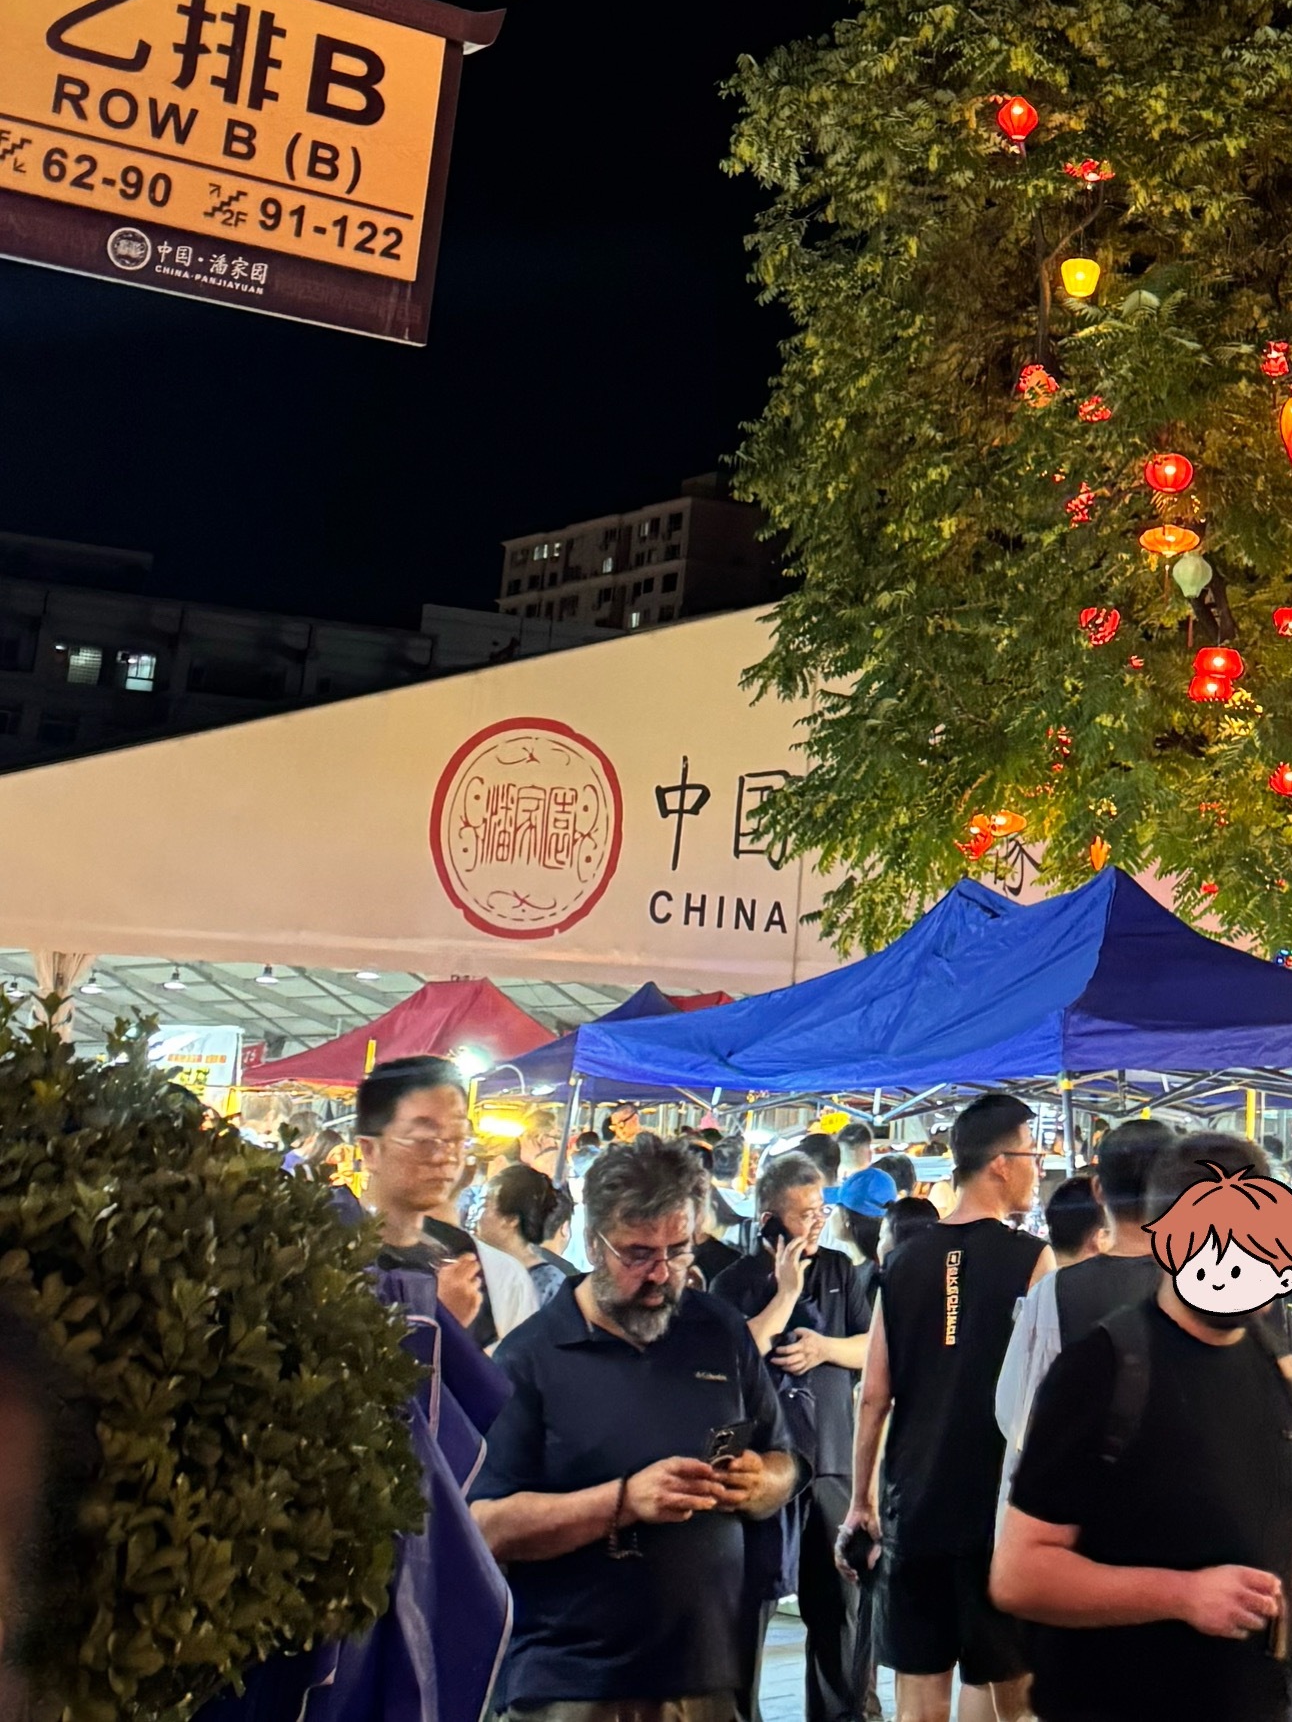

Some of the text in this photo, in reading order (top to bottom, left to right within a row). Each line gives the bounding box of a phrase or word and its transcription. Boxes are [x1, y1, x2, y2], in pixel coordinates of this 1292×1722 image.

[52, 73, 362, 195] ROW B (B)
[42, 146, 173, 208] 62-90
[220, 208, 248, 228] 2F
[258, 196, 404, 262] 91-122
[649, 889, 788, 934] CHINA
